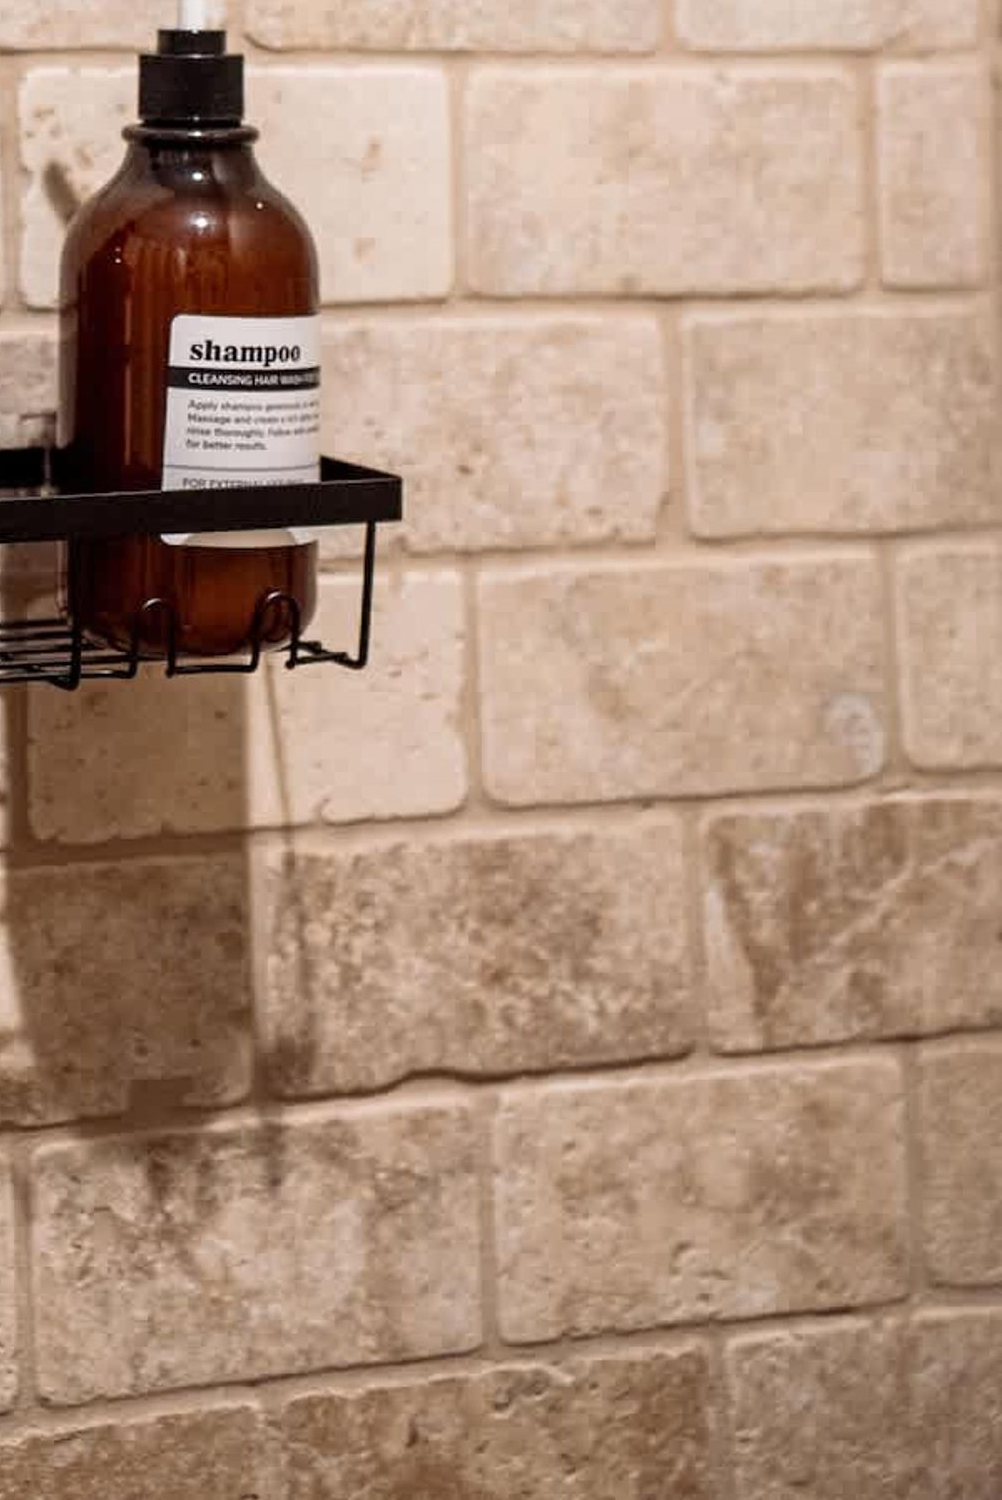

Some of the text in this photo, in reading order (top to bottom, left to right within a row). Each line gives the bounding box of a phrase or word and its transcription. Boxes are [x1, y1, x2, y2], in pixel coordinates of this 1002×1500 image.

[189, 339, 302, 368] shampoo
[188, 372, 253, 386] CLEANSING
[254, 373, 279, 386] HAIR
[188, 399, 218, 412] Apply
[187, 412, 231, 426] Massage
[234, 415, 252, 425] and
[185, 438, 201, 449] for
[203, 440, 233, 450] better
